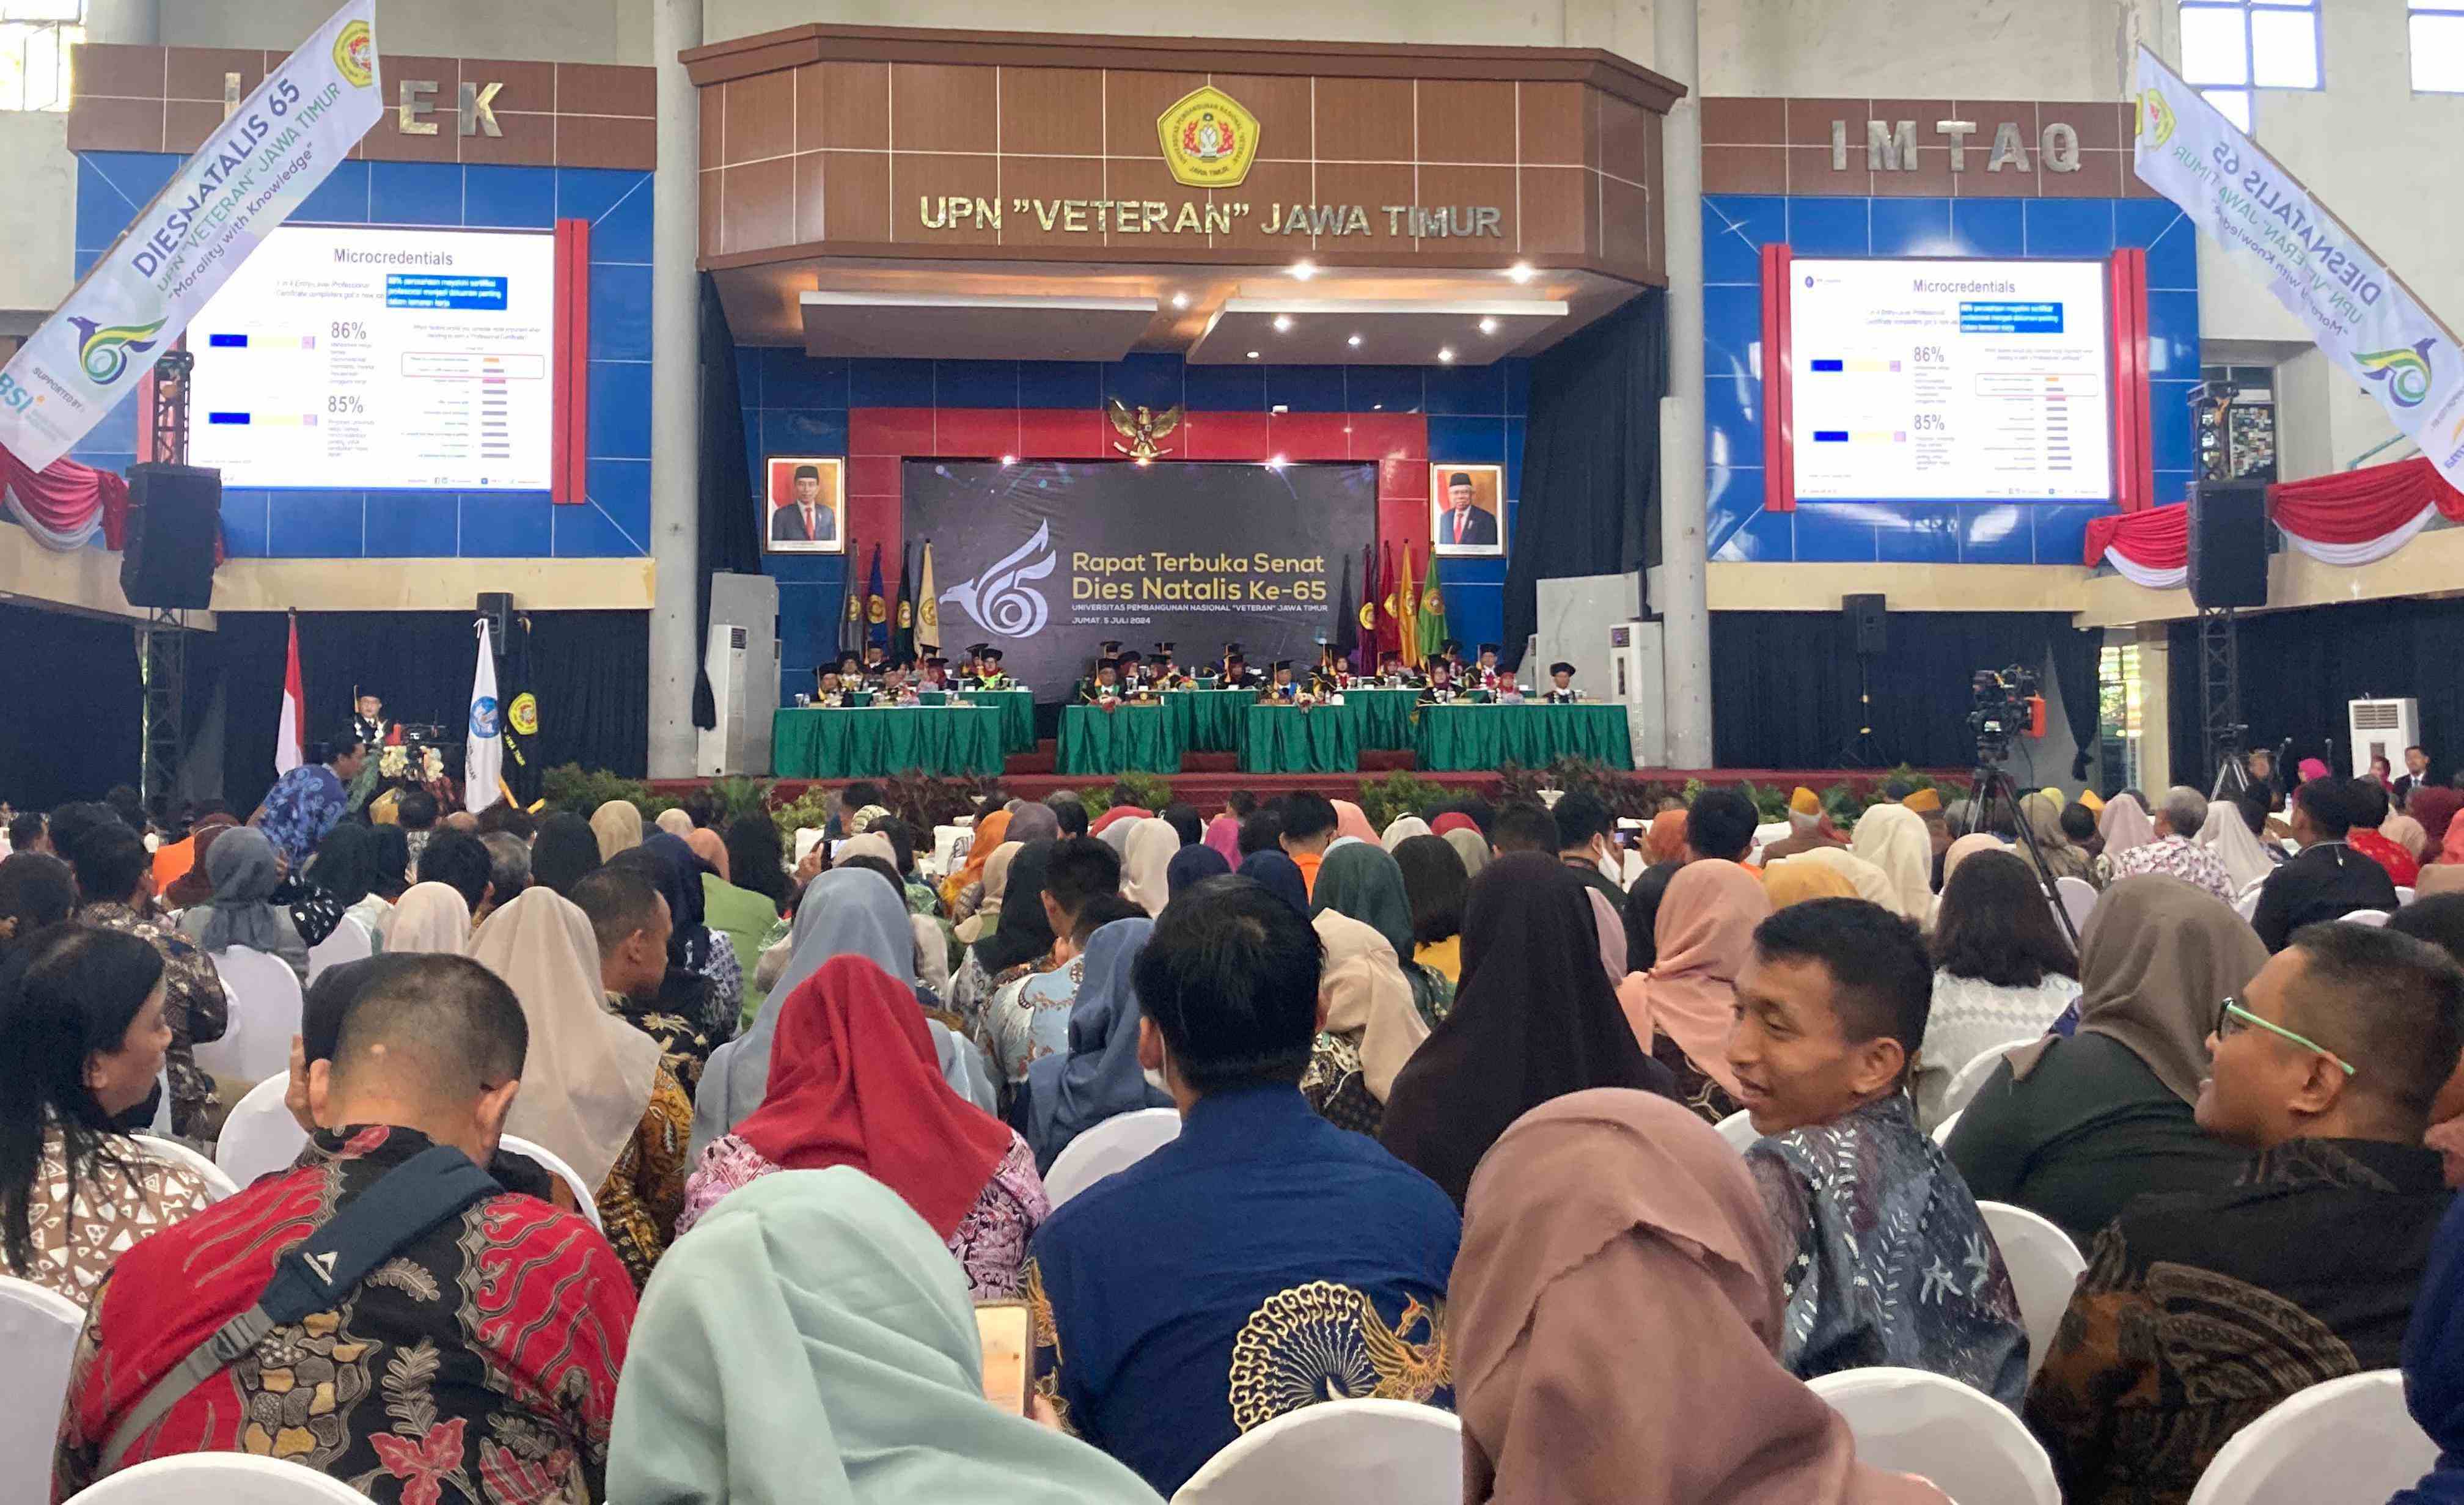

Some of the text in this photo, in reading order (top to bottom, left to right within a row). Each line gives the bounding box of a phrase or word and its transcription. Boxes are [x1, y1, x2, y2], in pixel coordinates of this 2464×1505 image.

[1832, 120, 2082, 173] IMTAQ
[131, 78, 300, 278] DIESNATALIS 65
[157, 254, 185, 292] UPN
[258, 126, 301, 172] JAWA
[295, 82, 340, 129] TIMUR
[222, 214, 249, 244] with
[920, 196, 1002, 230] UPN
[1260, 202, 1372, 236] JAWA
[1381, 205, 1502, 238] TIMUR
[334, 248, 453, 266] Microcredentials
[1913, 279, 2016, 293] Microcredentials
[331, 321, 367, 340] 86%
[1913, 346, 1945, 363] 86%
[328, 395, 364, 414] 85%
[1913, 415, 1945, 431] 85%
[1072, 552, 1325, 576] Rapat Terbuka Senat
[1072, 576, 1327, 600] Dies Natalis Ke-65
